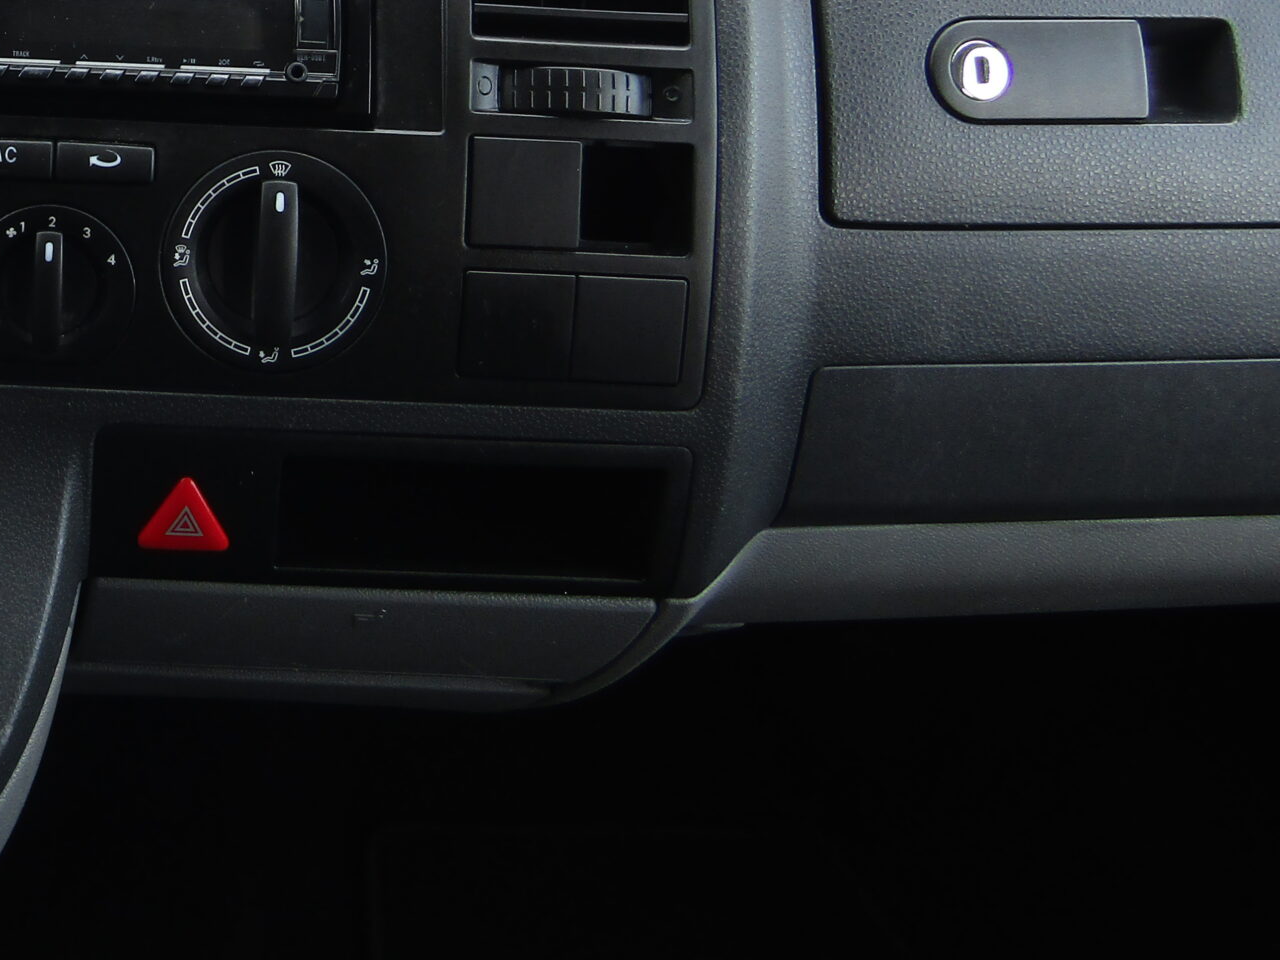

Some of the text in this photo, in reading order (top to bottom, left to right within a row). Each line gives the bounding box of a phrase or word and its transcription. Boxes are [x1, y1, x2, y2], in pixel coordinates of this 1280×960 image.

[19, 221, 25, 233] 1
[48, 215, 57, 228] 2
[82, 227, 92, 239] 3
[107, 253, 117, 266] 4
